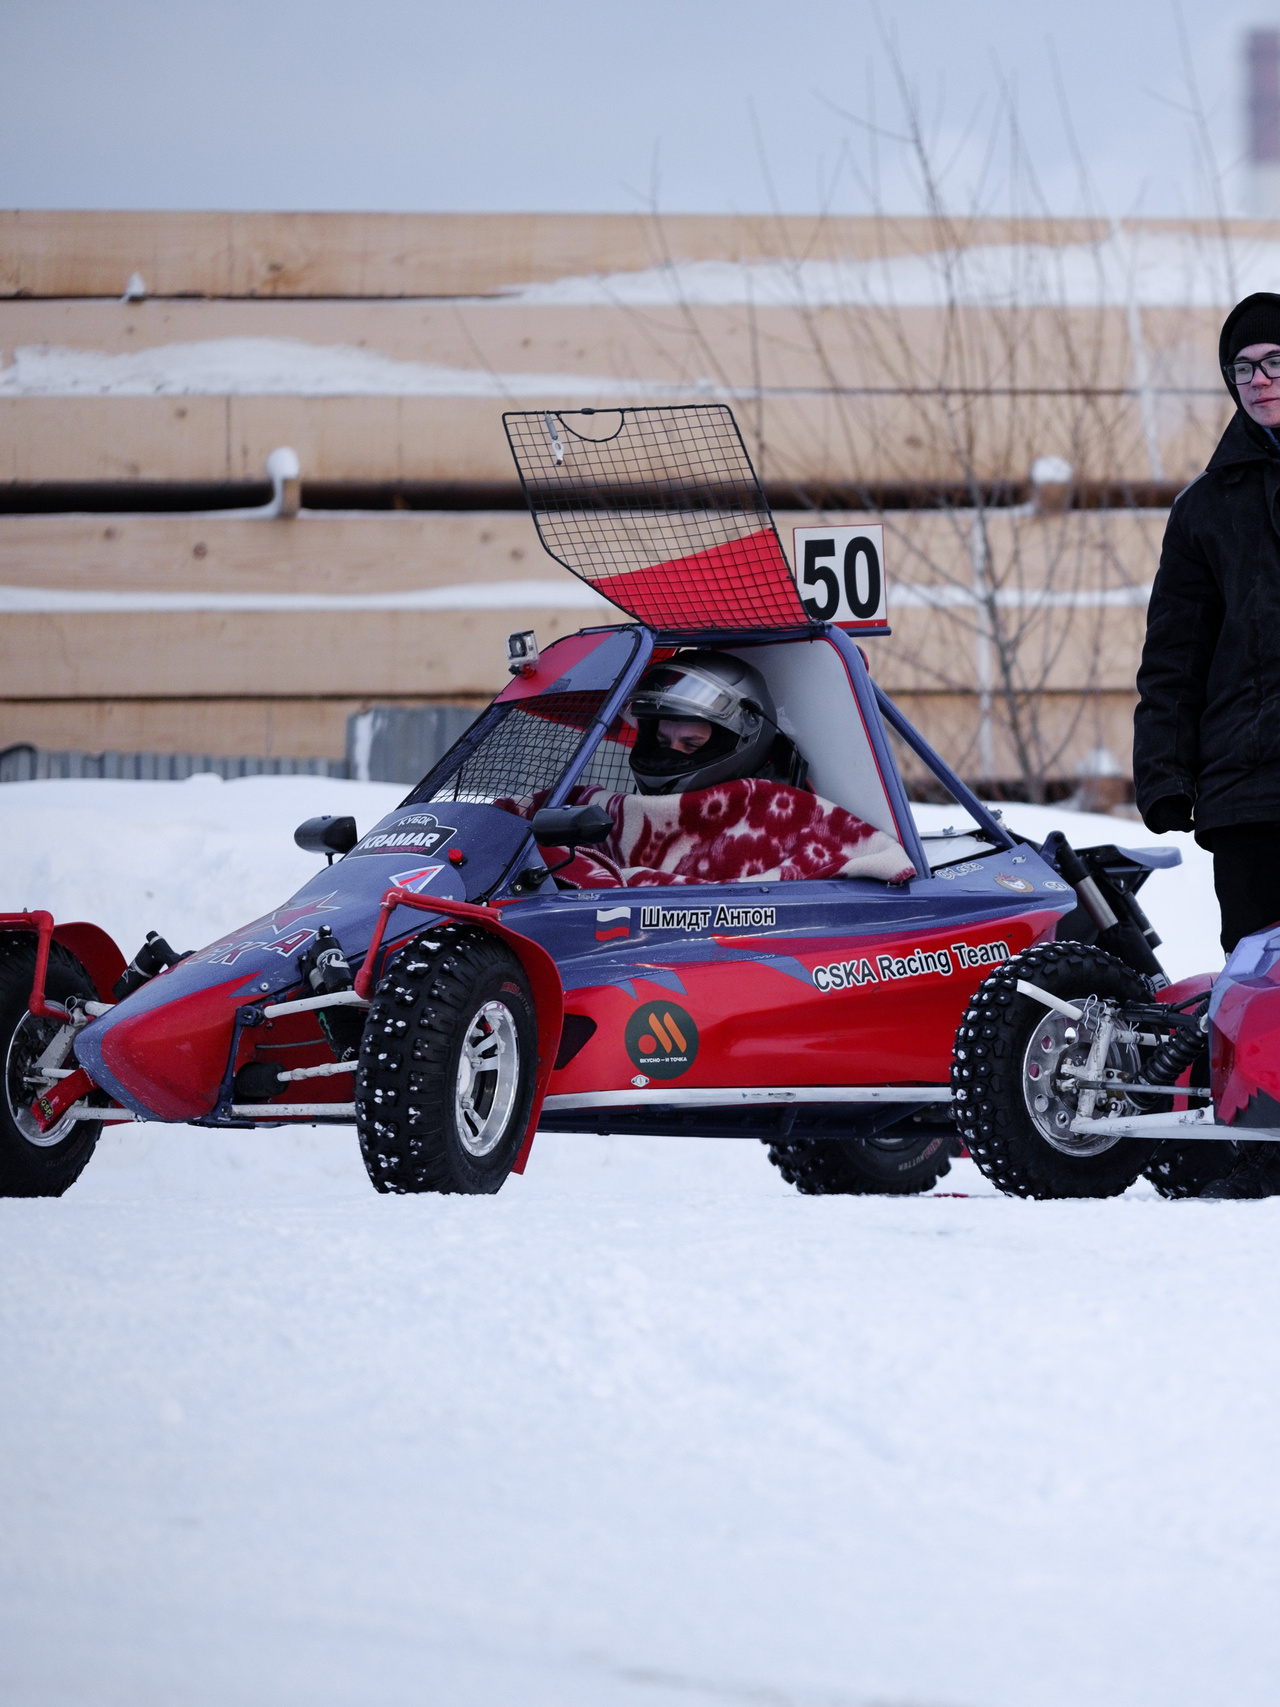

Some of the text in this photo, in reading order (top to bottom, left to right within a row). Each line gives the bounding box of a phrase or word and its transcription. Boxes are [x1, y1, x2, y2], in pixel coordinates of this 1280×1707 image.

[803, 536, 880, 620] 50
[397, 815, 433, 827] КУБОК
[358, 832, 440, 850] KRAMAR
[642, 904, 775, 931] Шмидт Антон
[813, 941, 1010, 991] CSKA Racing Team
[40, 1099, 54, 1116] QSP
